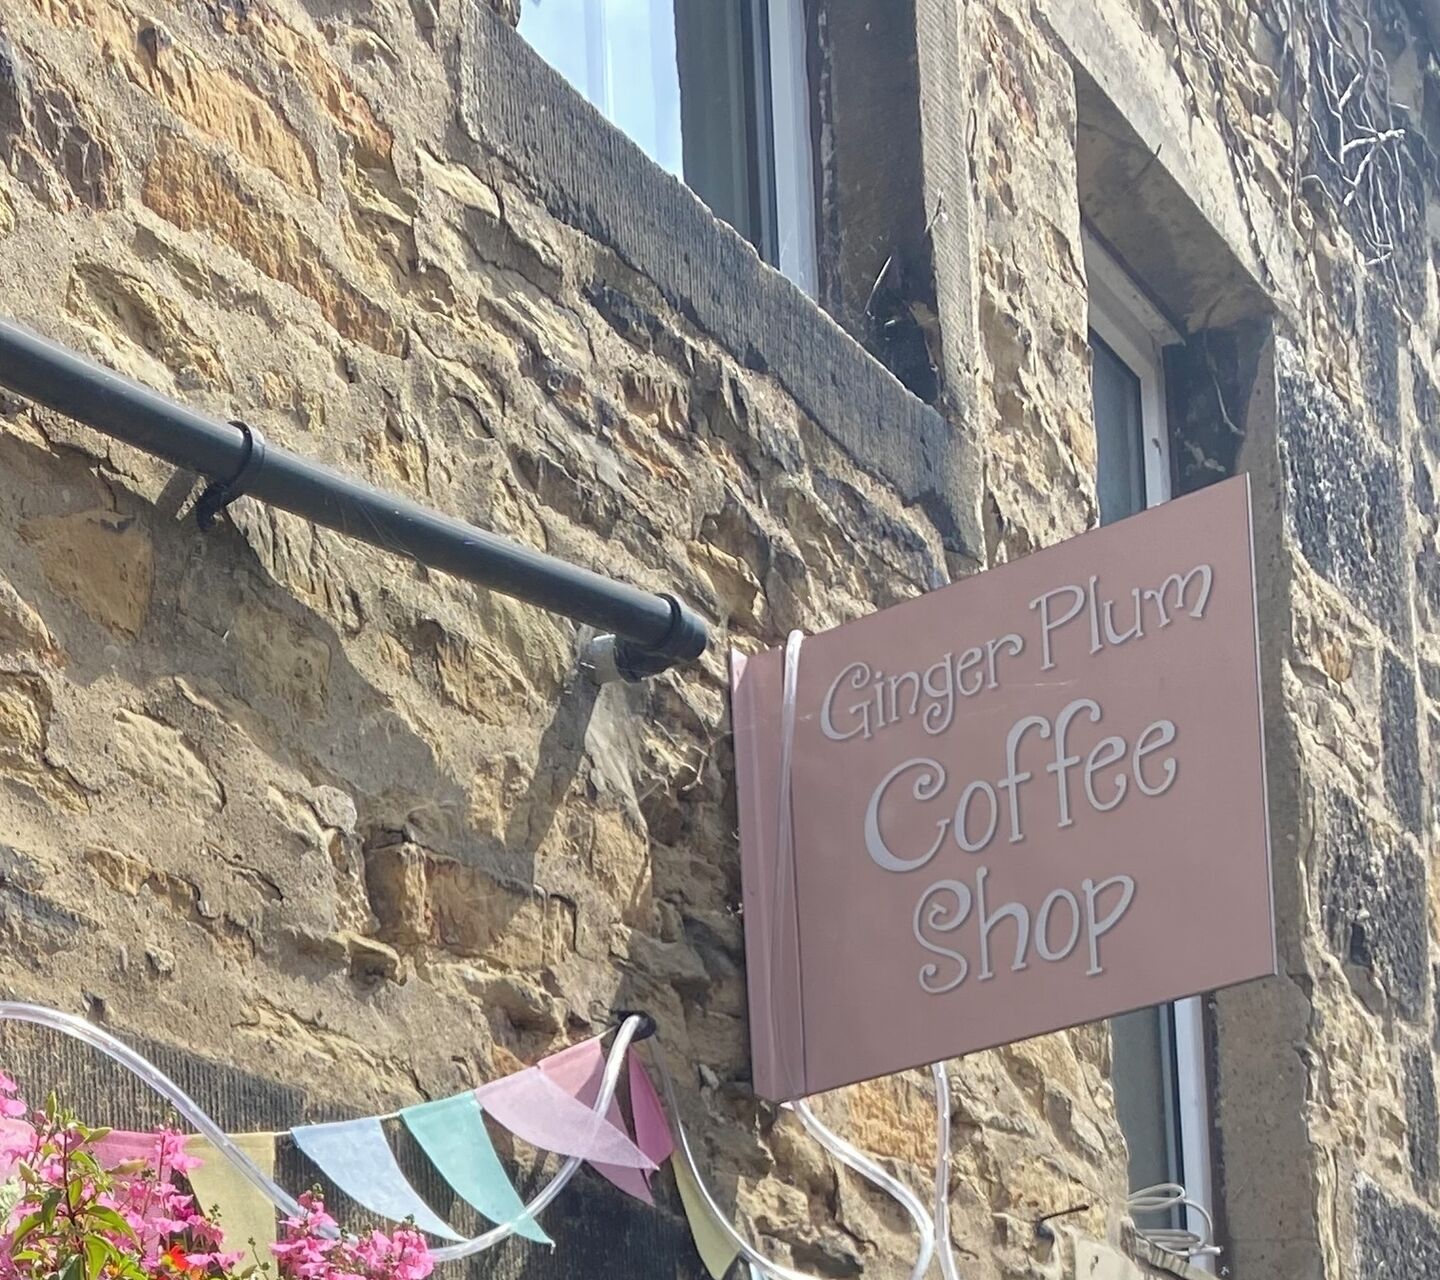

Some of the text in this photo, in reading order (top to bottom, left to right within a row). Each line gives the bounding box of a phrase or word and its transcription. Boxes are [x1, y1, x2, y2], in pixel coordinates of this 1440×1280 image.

[820, 563, 1214, 741] Ginger Plum
[864, 698, 1179, 873] Coffee
[913, 866, 1136, 994] Shop
